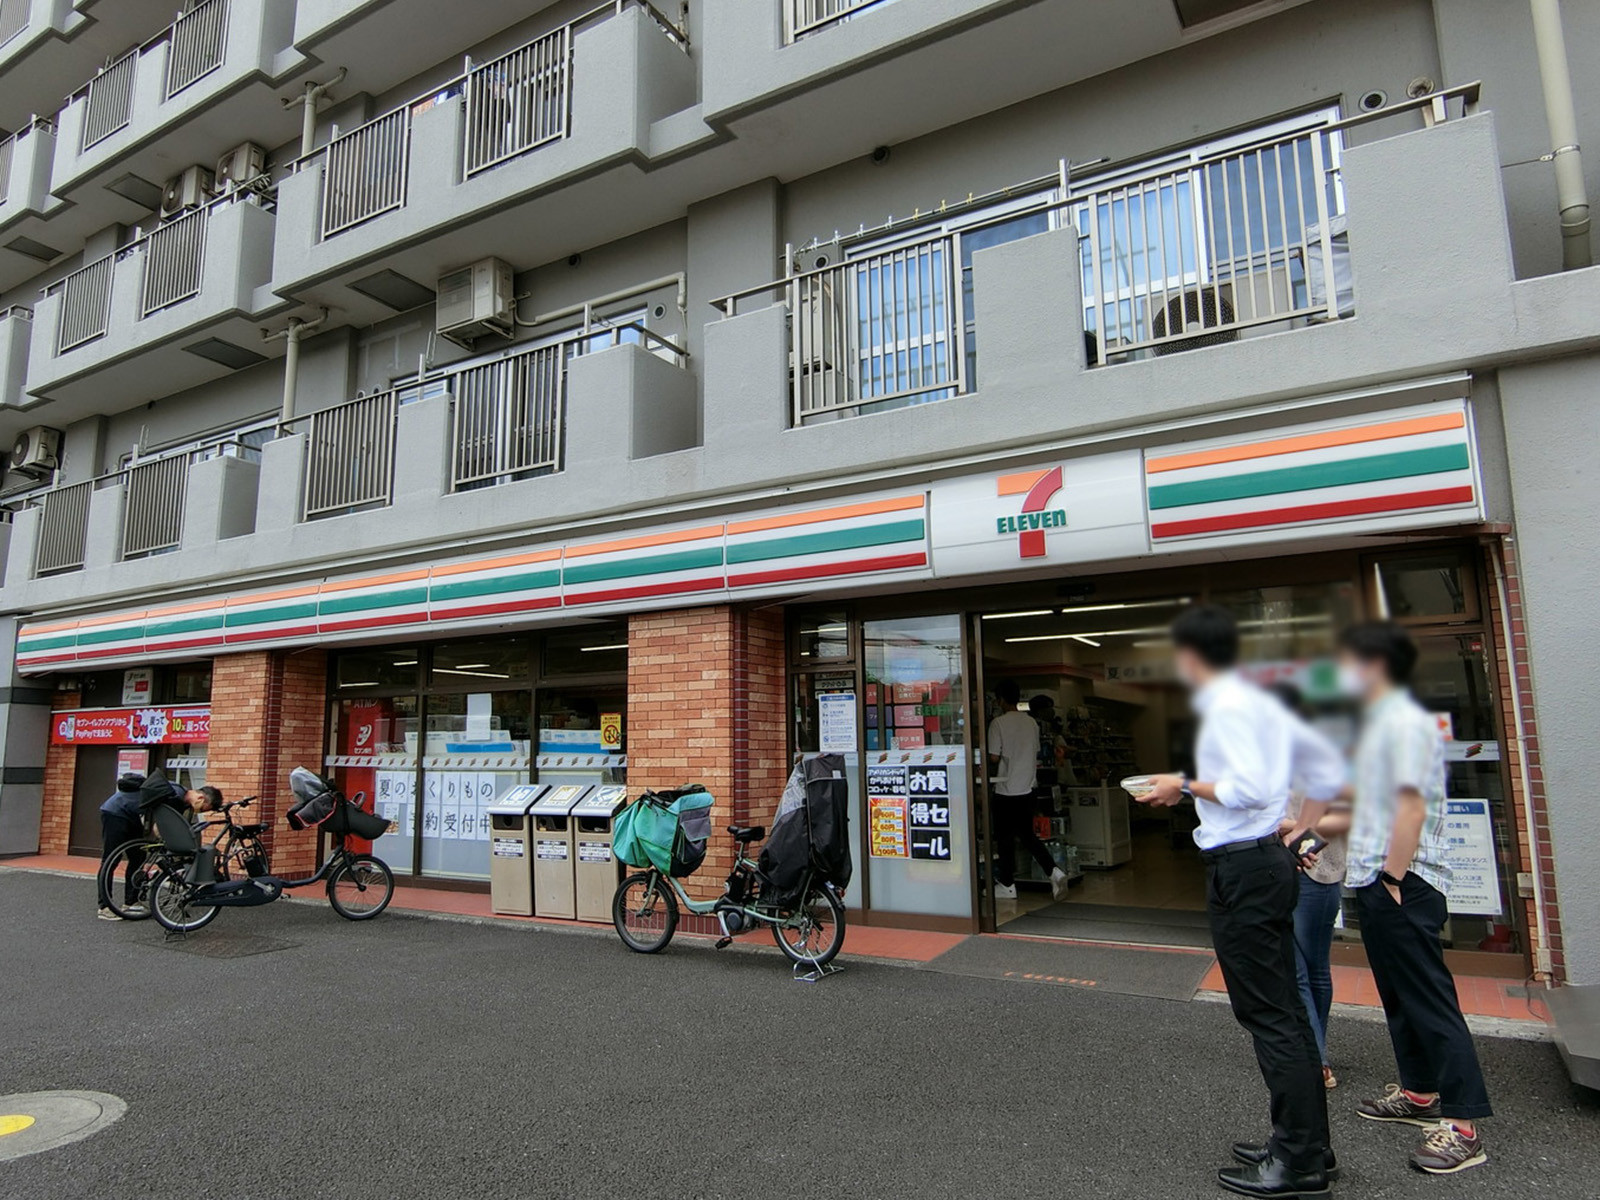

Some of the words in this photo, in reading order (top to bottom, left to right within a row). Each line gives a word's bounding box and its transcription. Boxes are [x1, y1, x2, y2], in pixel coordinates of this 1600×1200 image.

[909, 770, 947, 792] お買
[910, 802, 948, 825] 得セ
[912, 836, 949, 857] ール
